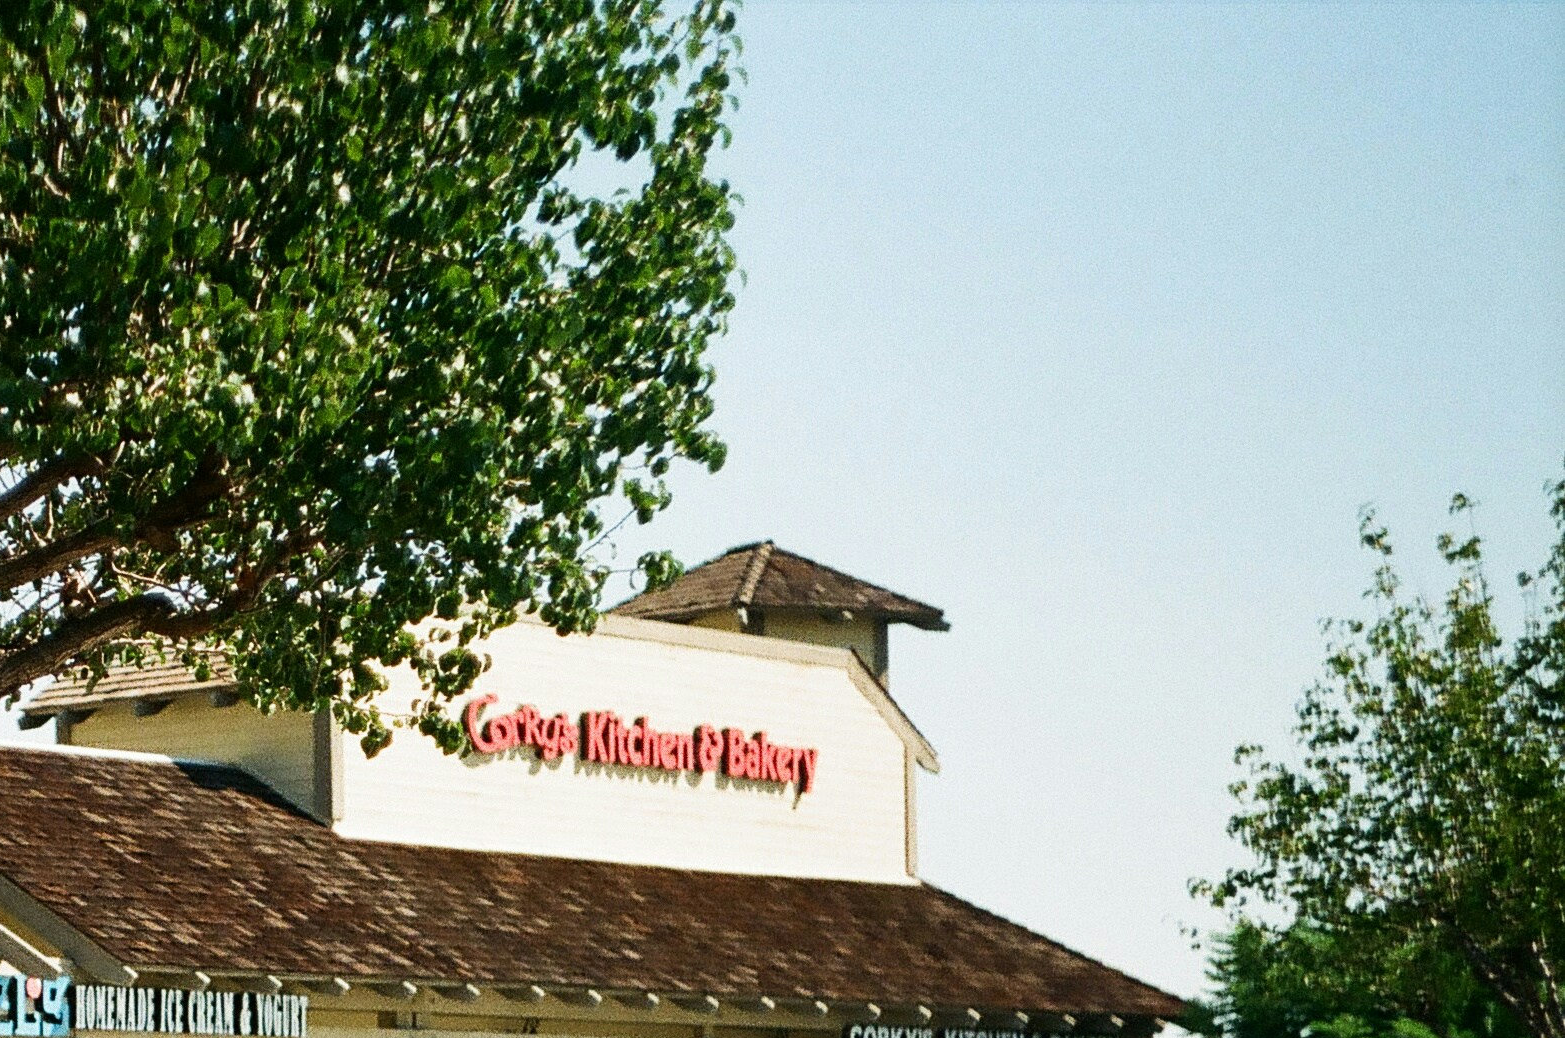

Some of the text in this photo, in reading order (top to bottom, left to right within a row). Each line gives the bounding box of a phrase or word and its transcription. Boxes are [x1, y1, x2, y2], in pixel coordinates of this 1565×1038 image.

[588, 710, 695, 770] Kitchen
[698, 723, 724, 772] &
[728, 727, 818, 794] Bakery
[75, 984, 309, 1038] HOMEMADE ICE CREAM & YOGURT
